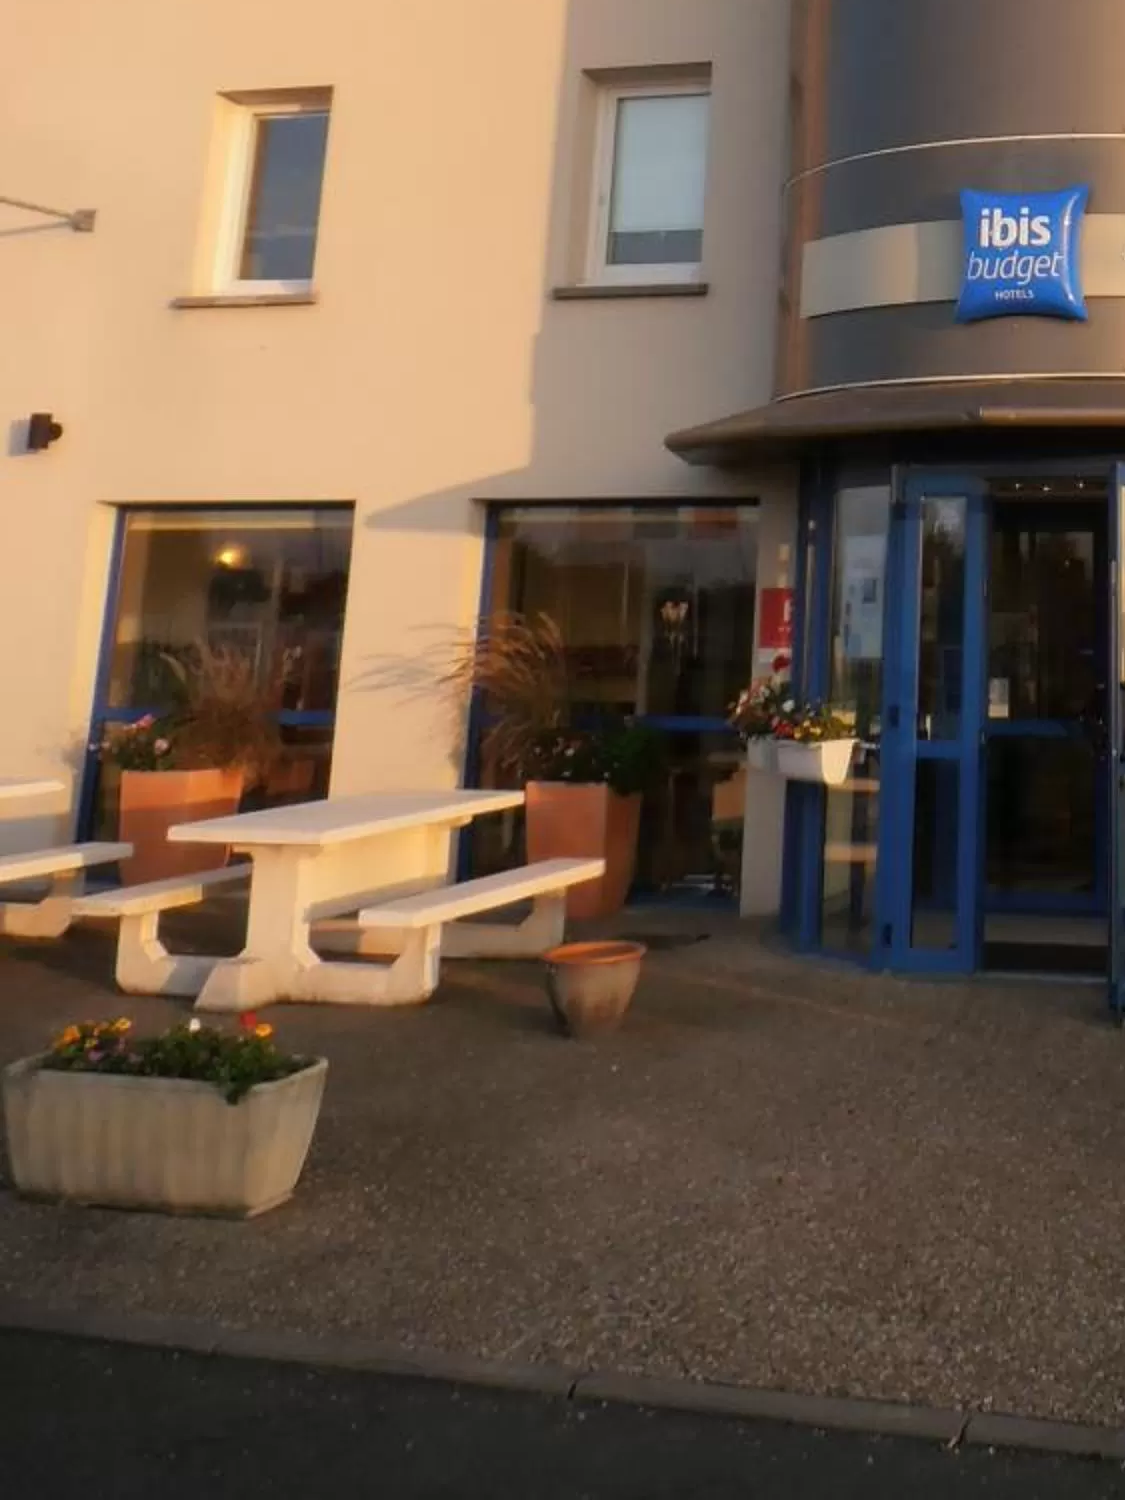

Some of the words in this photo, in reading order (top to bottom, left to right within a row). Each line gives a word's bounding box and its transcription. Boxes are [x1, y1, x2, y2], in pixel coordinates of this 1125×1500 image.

[980, 206, 1051, 248] ibis
[967, 251, 1065, 286] budget
[995, 289, 1034, 300] HOTELS
